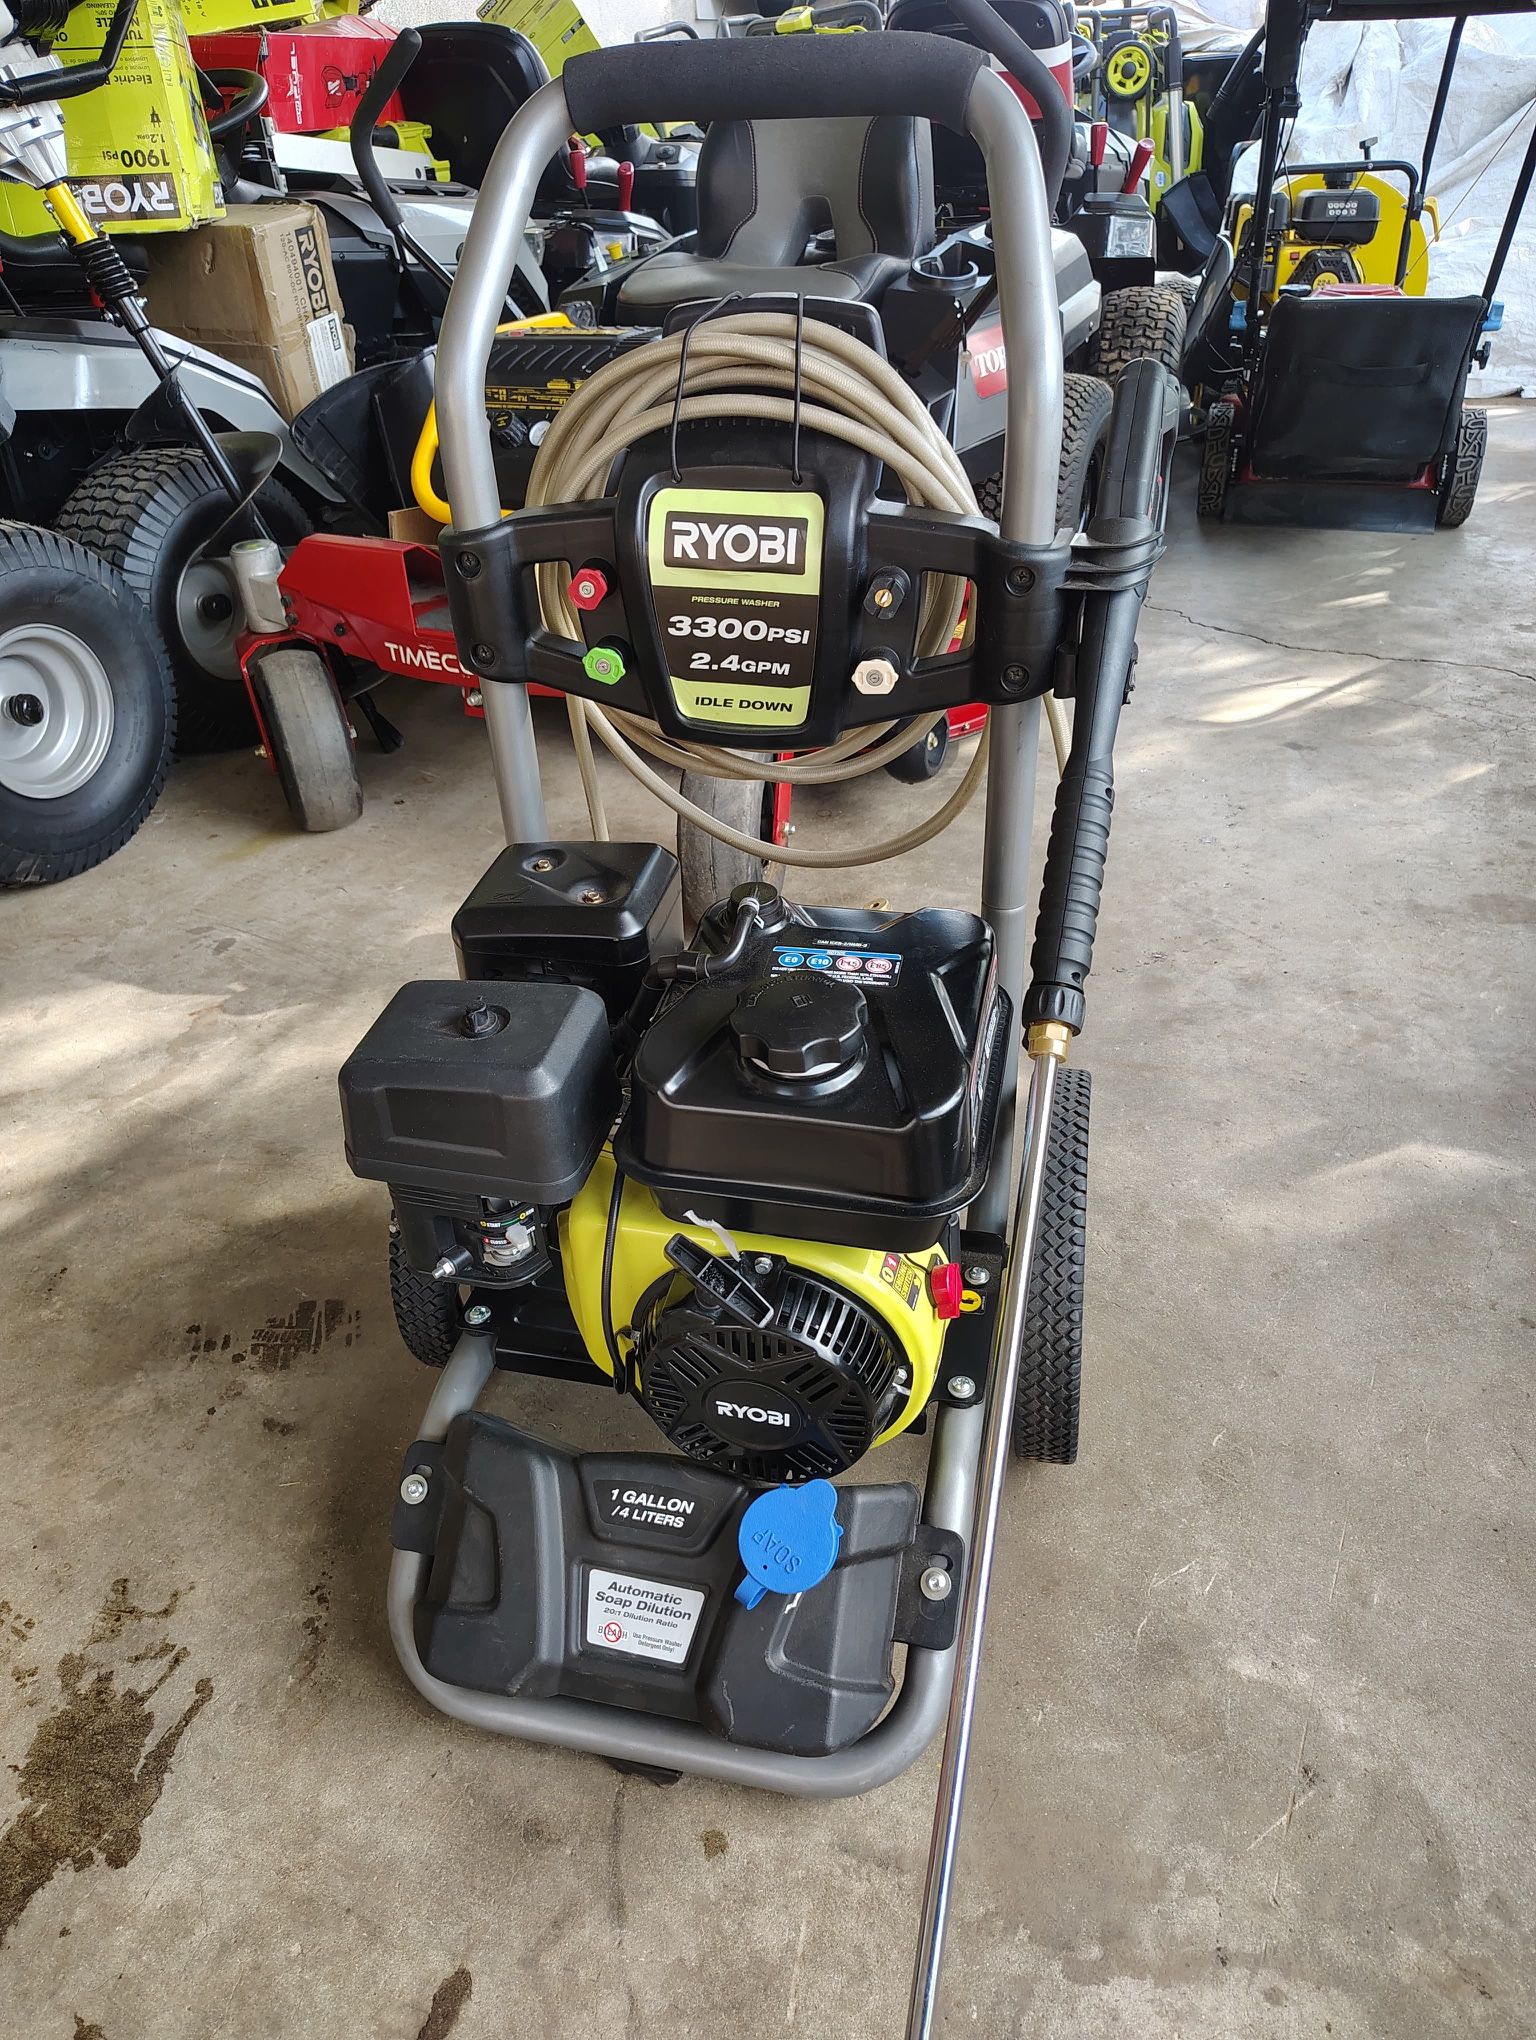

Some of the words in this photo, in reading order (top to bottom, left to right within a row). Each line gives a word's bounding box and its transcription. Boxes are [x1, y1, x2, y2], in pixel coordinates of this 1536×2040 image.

[114, 75, 153, 85] Electric
[102, 150, 119, 160] PSI
[120, 148, 171, 168] 1900
[79, 181, 175, 214] RYOB
[298, 230, 330, 318] RYOBI
[329, 320, 341, 349] RYOBI
[671, 521, 798, 565] RYOBI
[691, 595, 739, 605] PRESSURE
[741, 598, 780, 608] WASHER
[695, 696, 734, 708] IDLE
[738, 699, 793, 712] DOWN
[784, 955, 798, 963] E0
[810, 957, 829, 965] E10
[715, 1400, 790, 1427] RYOBI
[611, 1488, 620, 1501] 1
[622, 1490, 695, 1514] GALLON
[632, 1508, 685, 1528] LITERS
[752, 1529, 802, 1575] SOAP
[595, 1591, 633, 1609] Soap
[636, 1600, 692, 1621] Dilution
[607, 1581, 683, 1606] Automatic
[603, 1607, 621, 1616] 20:1
[623, 1611, 654, 1623] Dilution
[656, 1618, 678, 1629] Ratio
